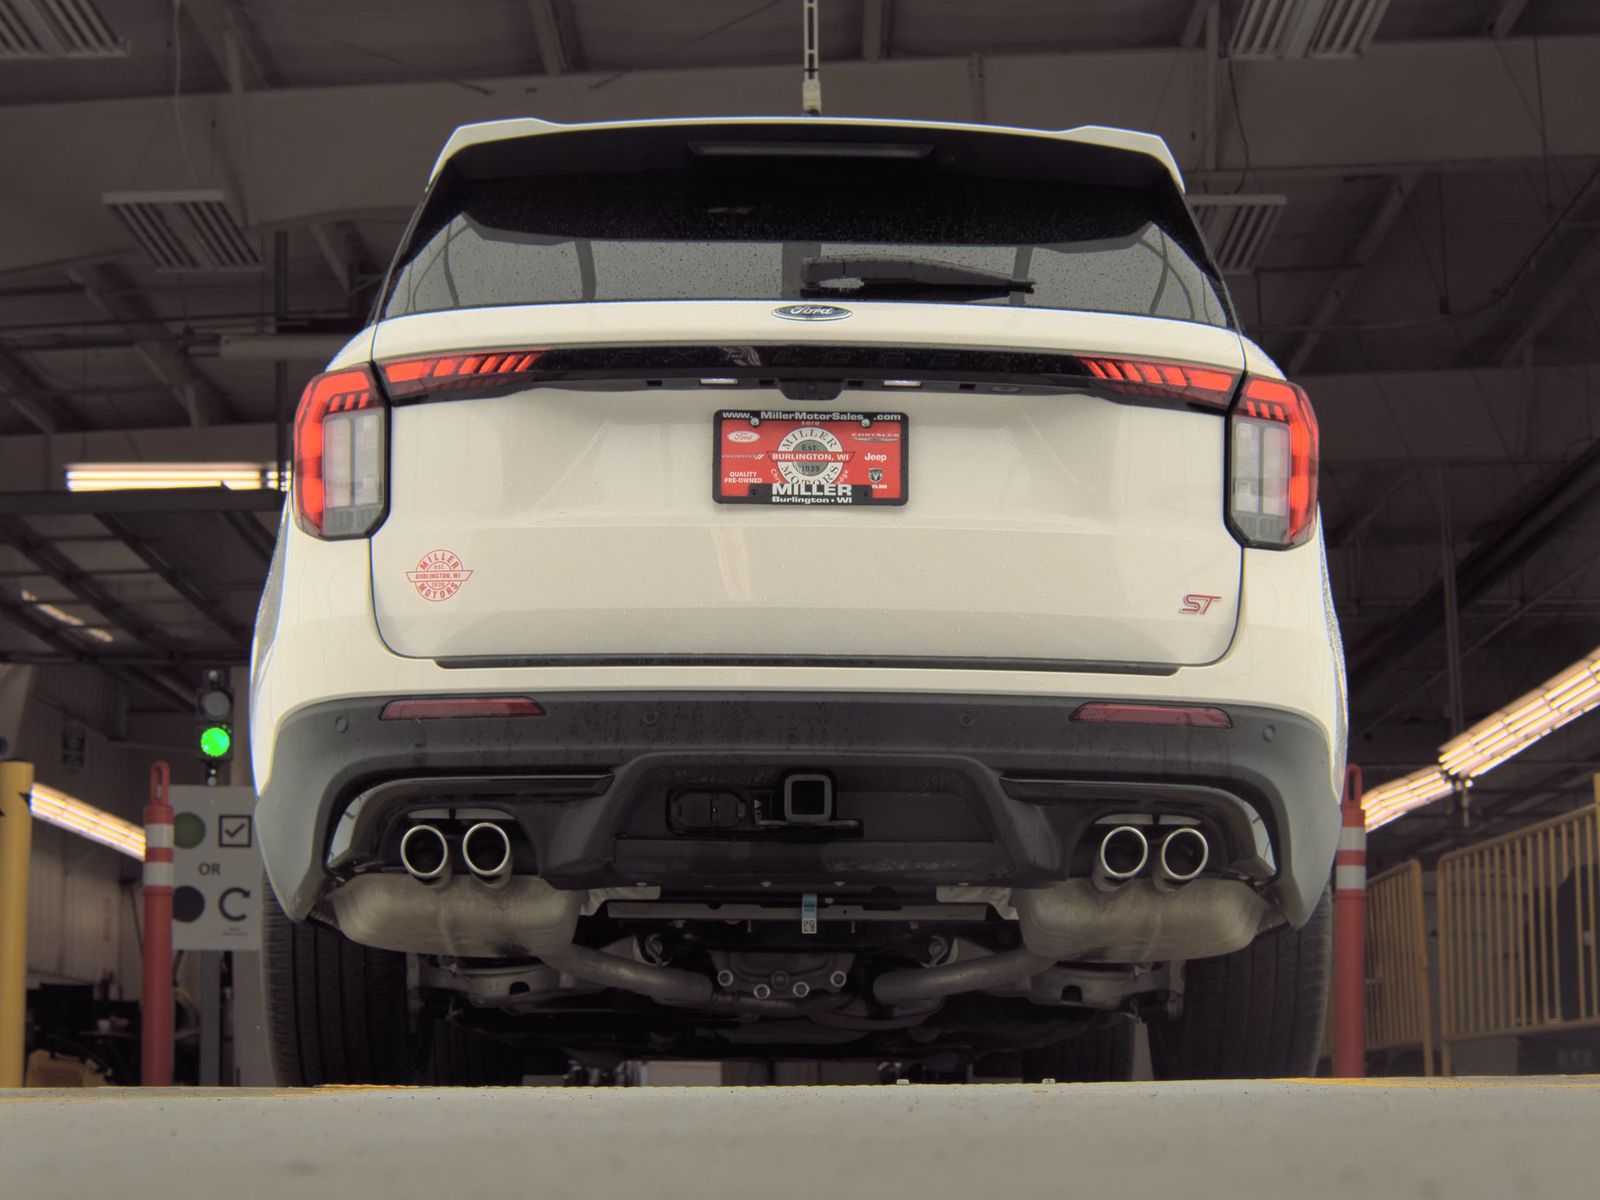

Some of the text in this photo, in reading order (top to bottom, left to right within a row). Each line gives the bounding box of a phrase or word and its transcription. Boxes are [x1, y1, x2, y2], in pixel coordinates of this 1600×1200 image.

[790, 306, 833, 315] Ford
[760, 411, 864, 420] MillerMotorSales
[734, 432, 753, 440] Ford
[782, 429, 837, 449] MILLER
[772, 453, 834, 461] BURLINGTON,
[864, 453, 887, 462] Jeep
[772, 483, 852, 496] MILLER
[772, 496, 829, 504] Burlington
[420, 552, 459, 570] MILLER
[418, 582, 458, 599] MOTORS
[1179, 594, 1222, 615] ST
[198, 862, 221, 876] OR
